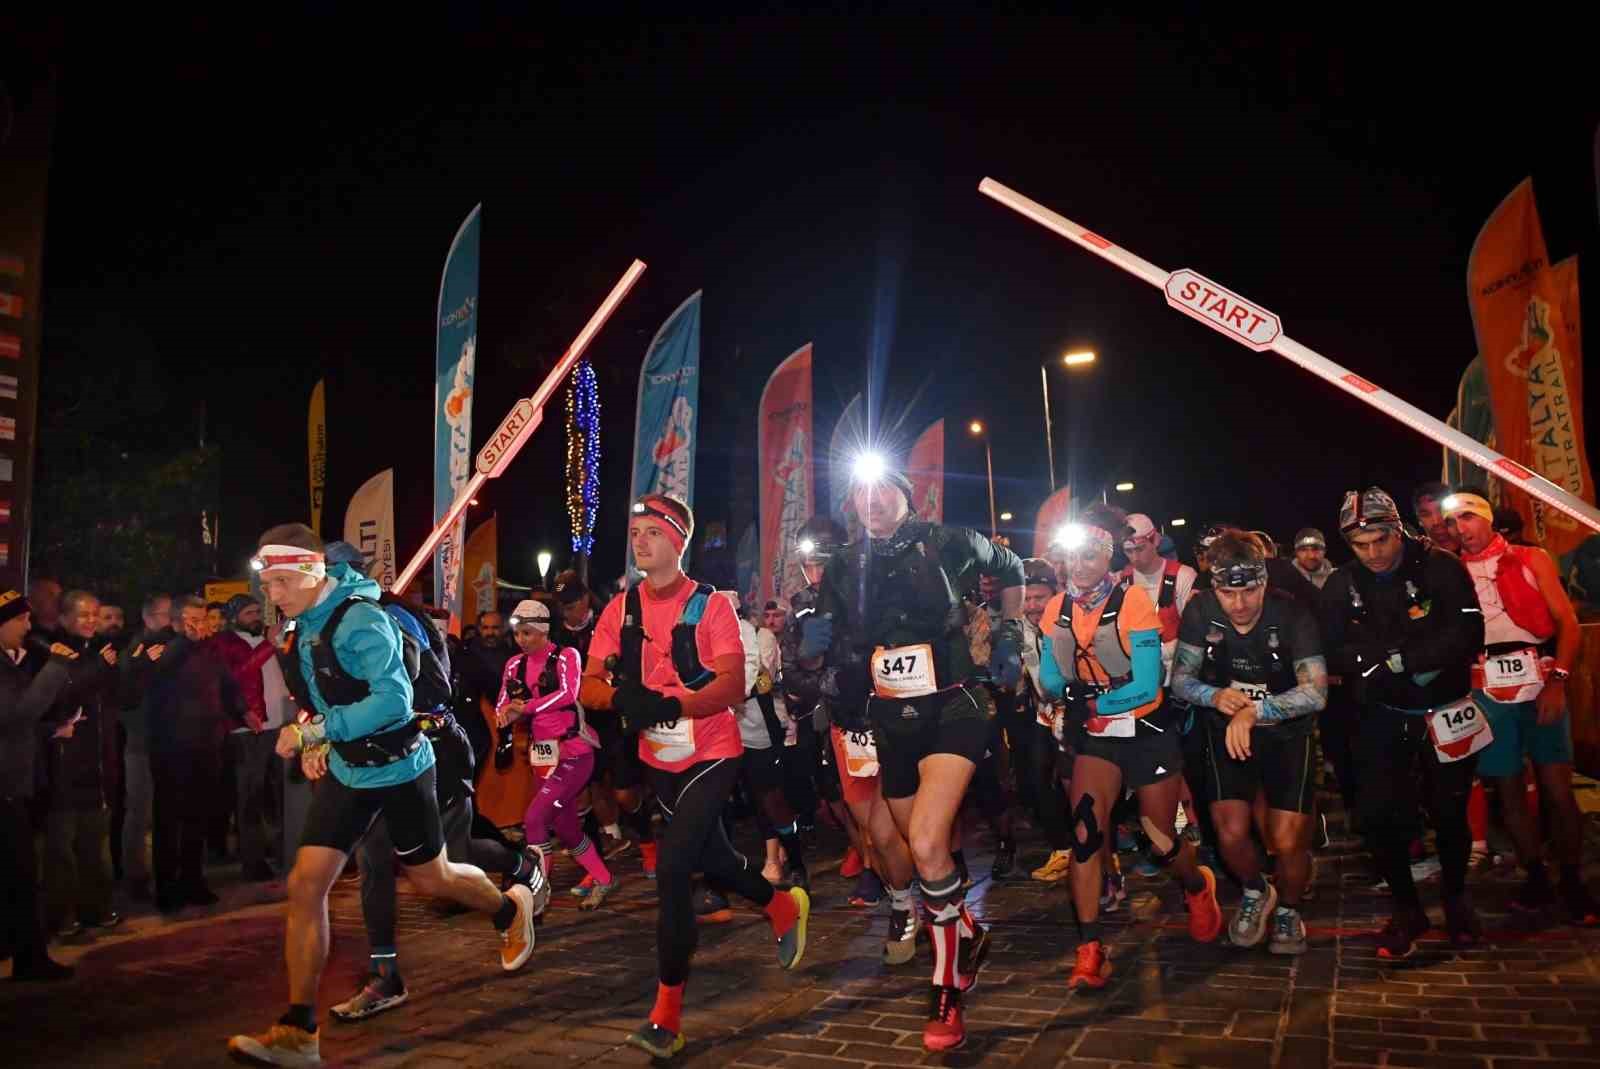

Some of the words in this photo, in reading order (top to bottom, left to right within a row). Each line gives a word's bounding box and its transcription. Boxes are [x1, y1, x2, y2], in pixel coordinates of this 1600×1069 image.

[1181, 280, 1267, 334] START
[484, 411, 529, 465] START
[1544, 354, 1580, 494] ULTRATRAIL
[881, 655, 916, 675] 347
[1497, 658, 1523, 673] 118
[1442, 706, 1476, 728] 140
